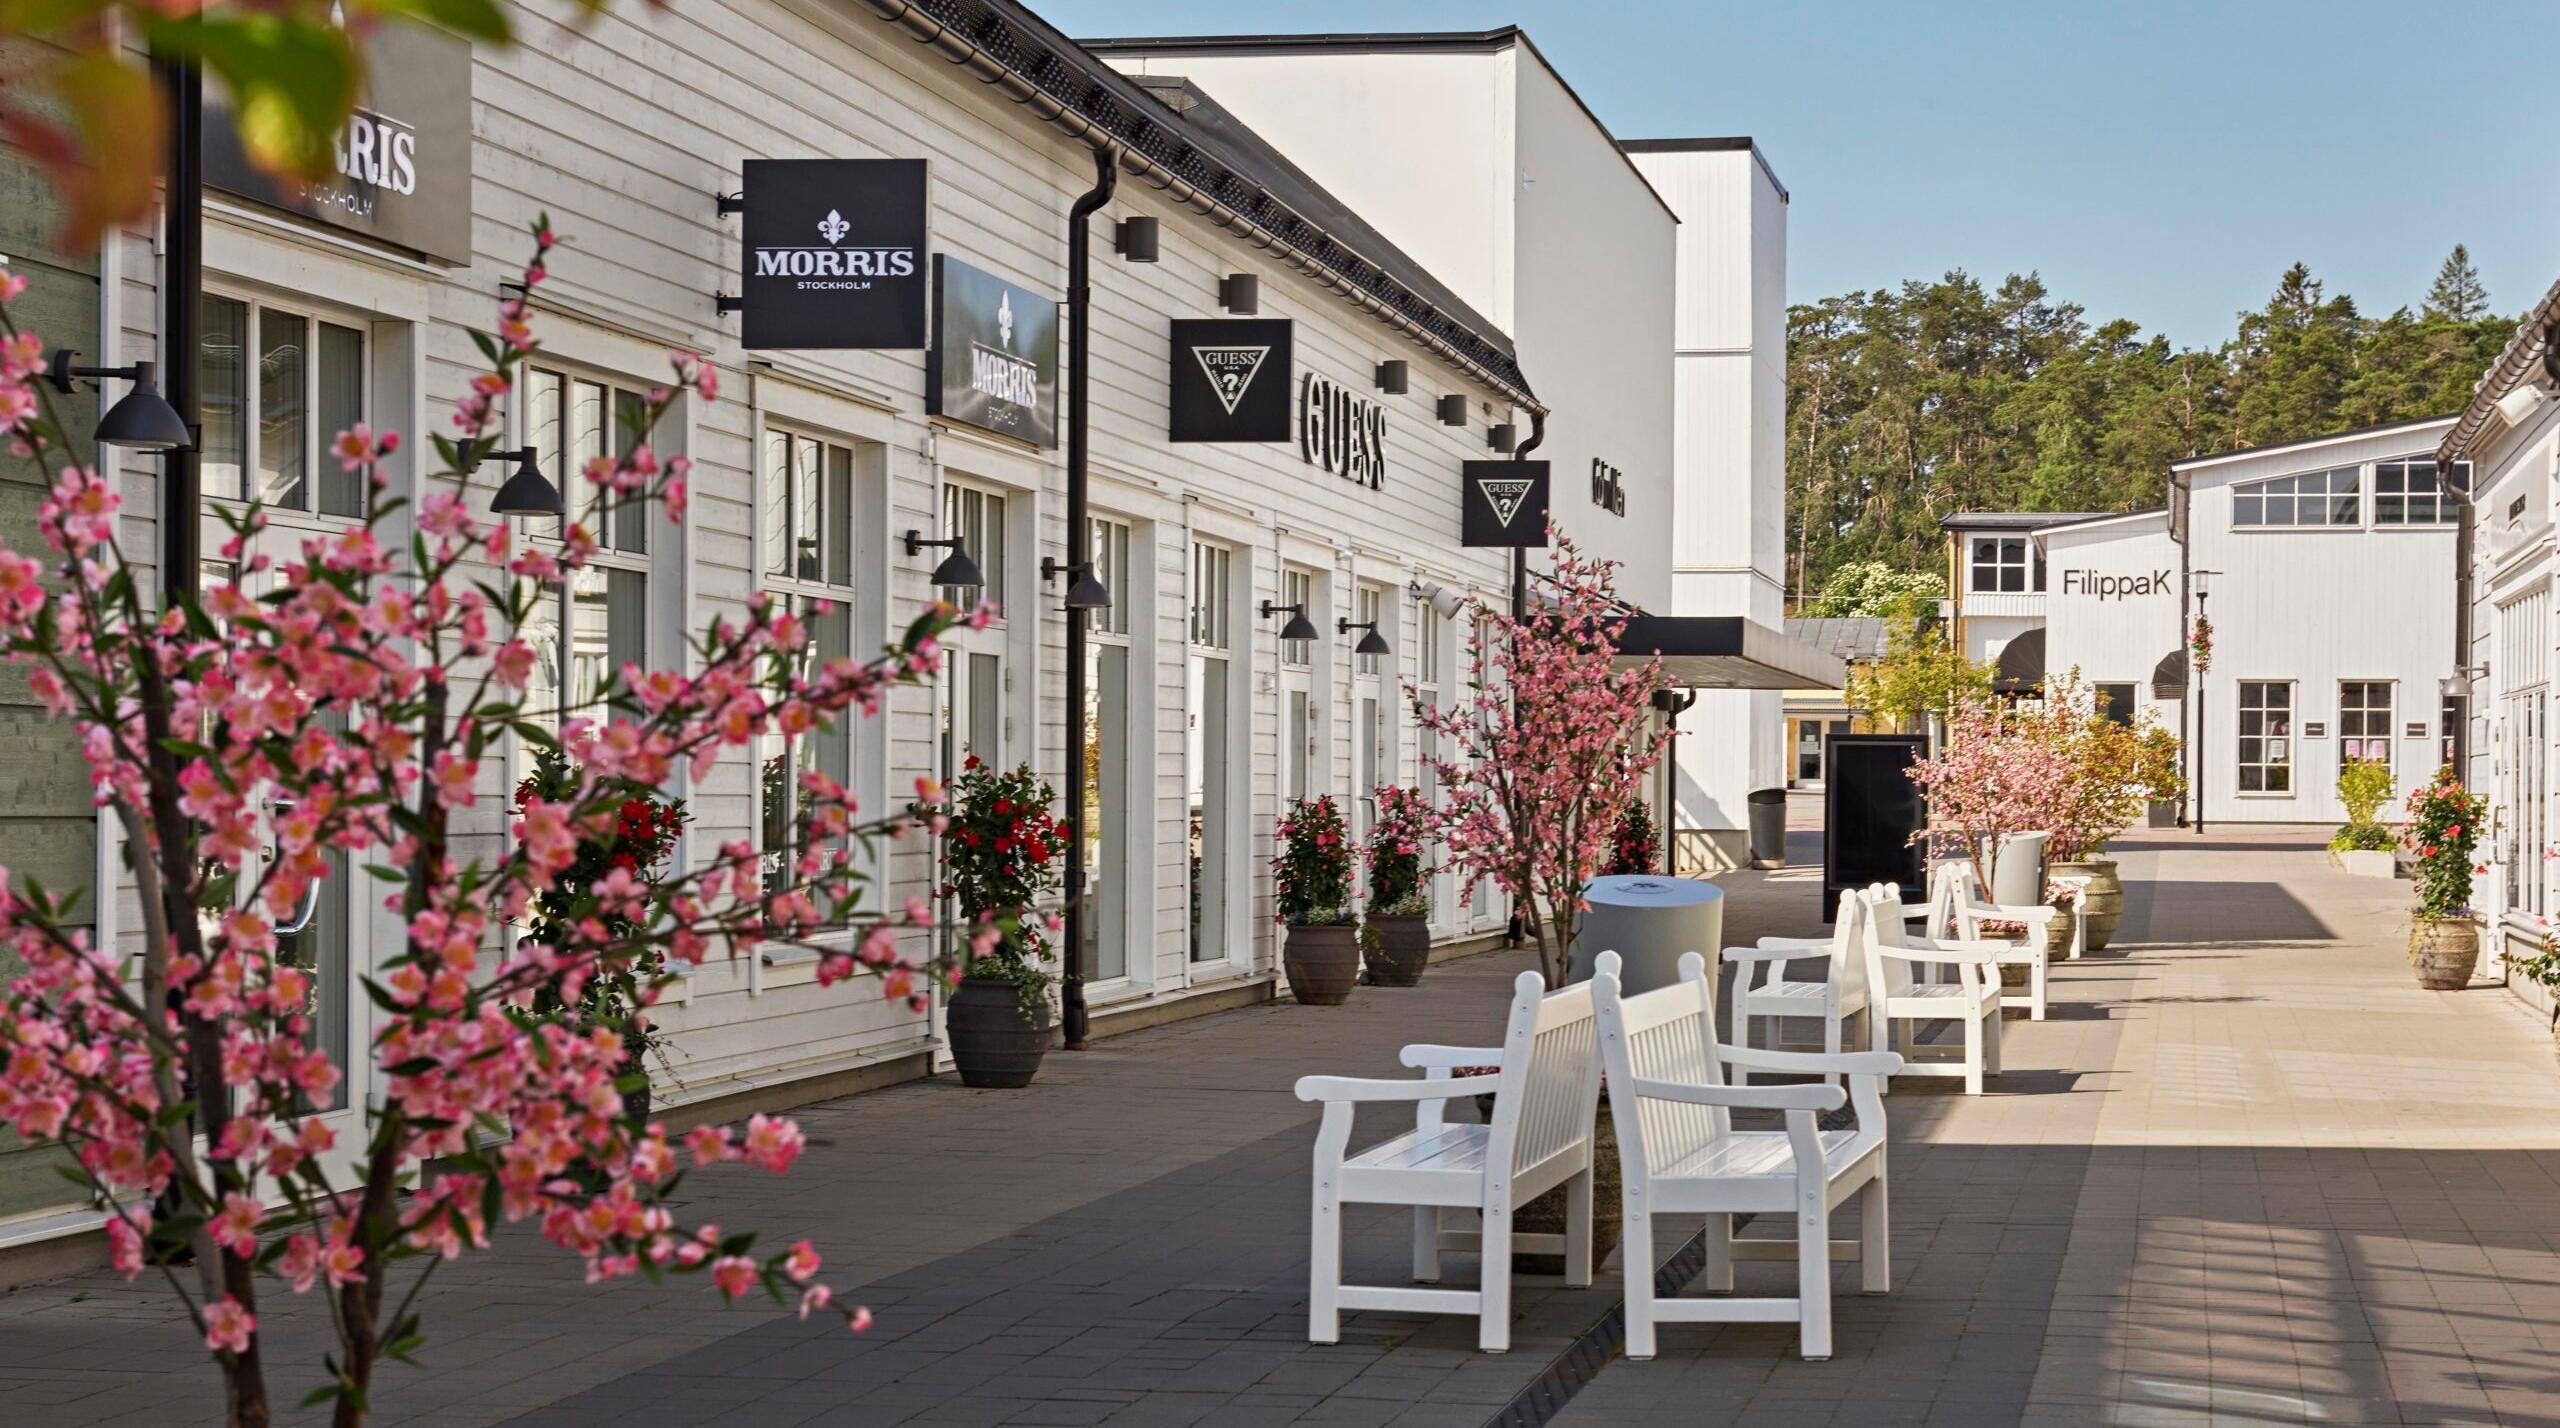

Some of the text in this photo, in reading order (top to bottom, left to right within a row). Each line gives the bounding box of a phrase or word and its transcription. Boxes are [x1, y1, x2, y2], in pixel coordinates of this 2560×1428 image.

[755, 250, 915, 277] MORRIS
[797, 280, 872, 291] STOCKHOLM
[1205, 352, 1257, 365] GUESS
[971, 348, 1038, 409] MORRIS
[1301, 372, 1388, 492] GUESS
[1487, 483, 1525, 493] GUESS
[2063, 568, 2172, 602] FilippaK
